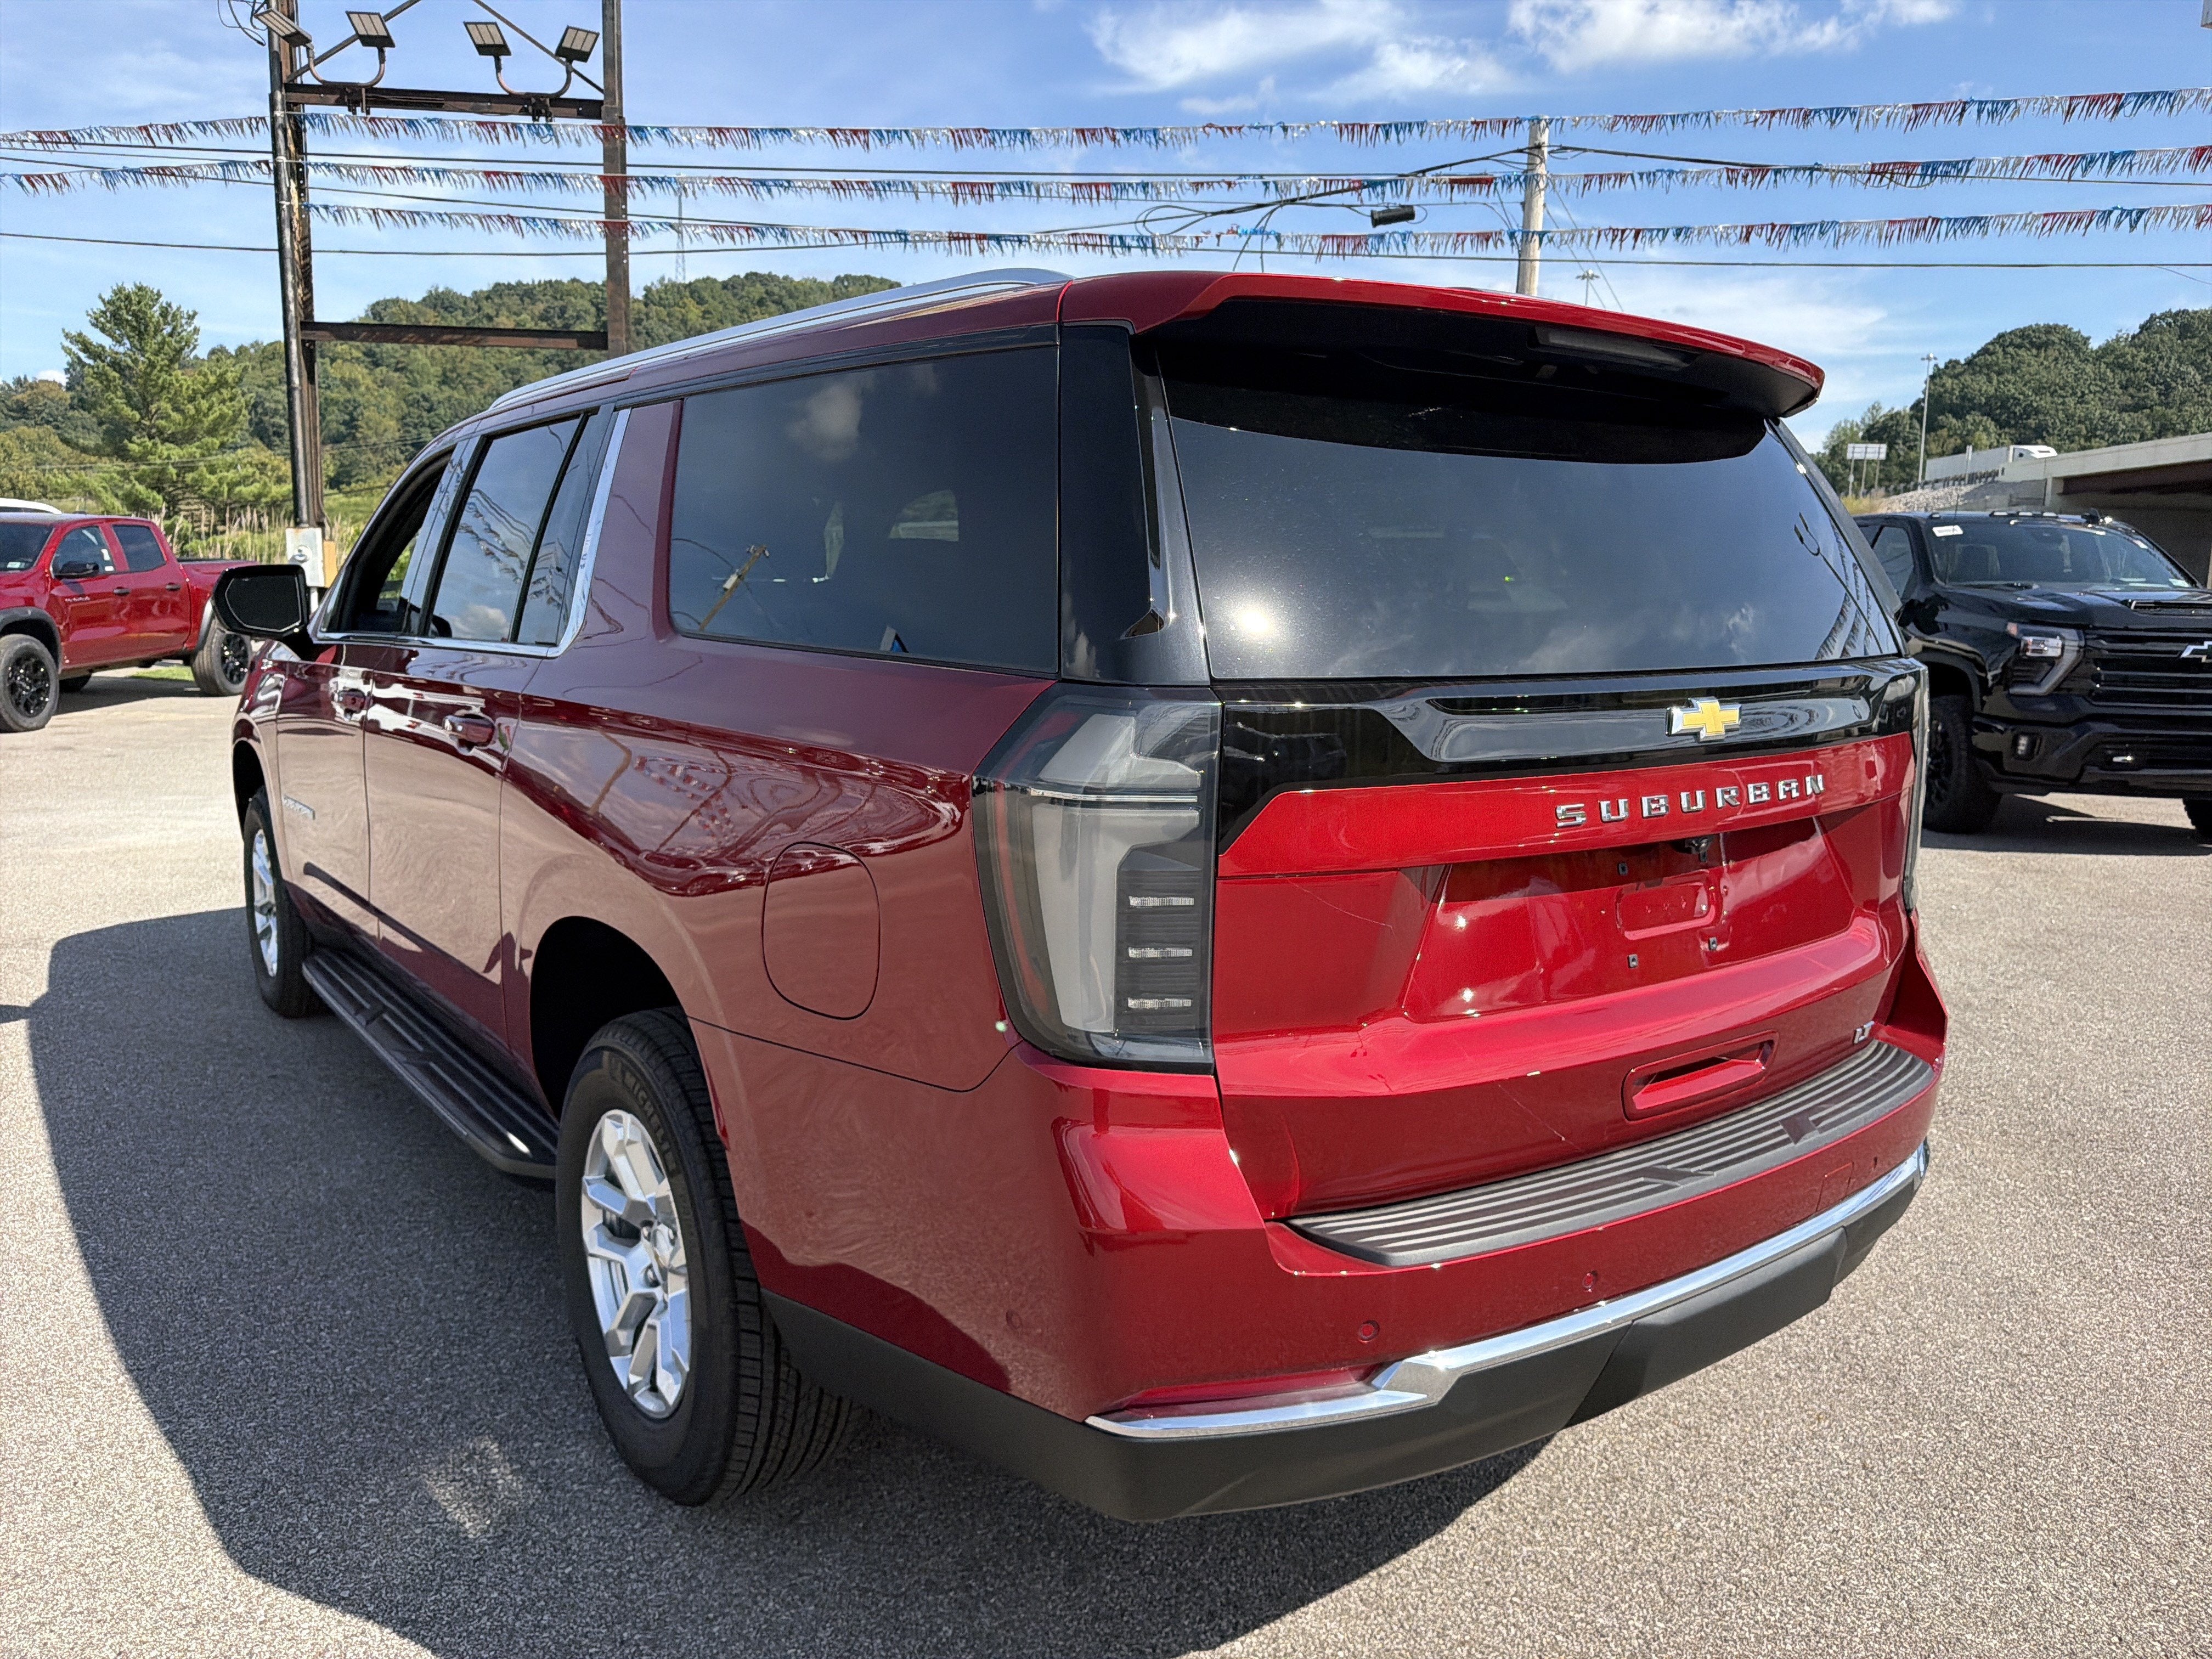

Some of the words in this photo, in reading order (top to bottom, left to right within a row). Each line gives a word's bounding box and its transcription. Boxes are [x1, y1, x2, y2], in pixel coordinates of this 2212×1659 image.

[1555, 774, 1825, 827] SUBURBAN
[1853, 1020, 1875, 1044] LT
[624, 1071, 677, 1171] MICHELIN
